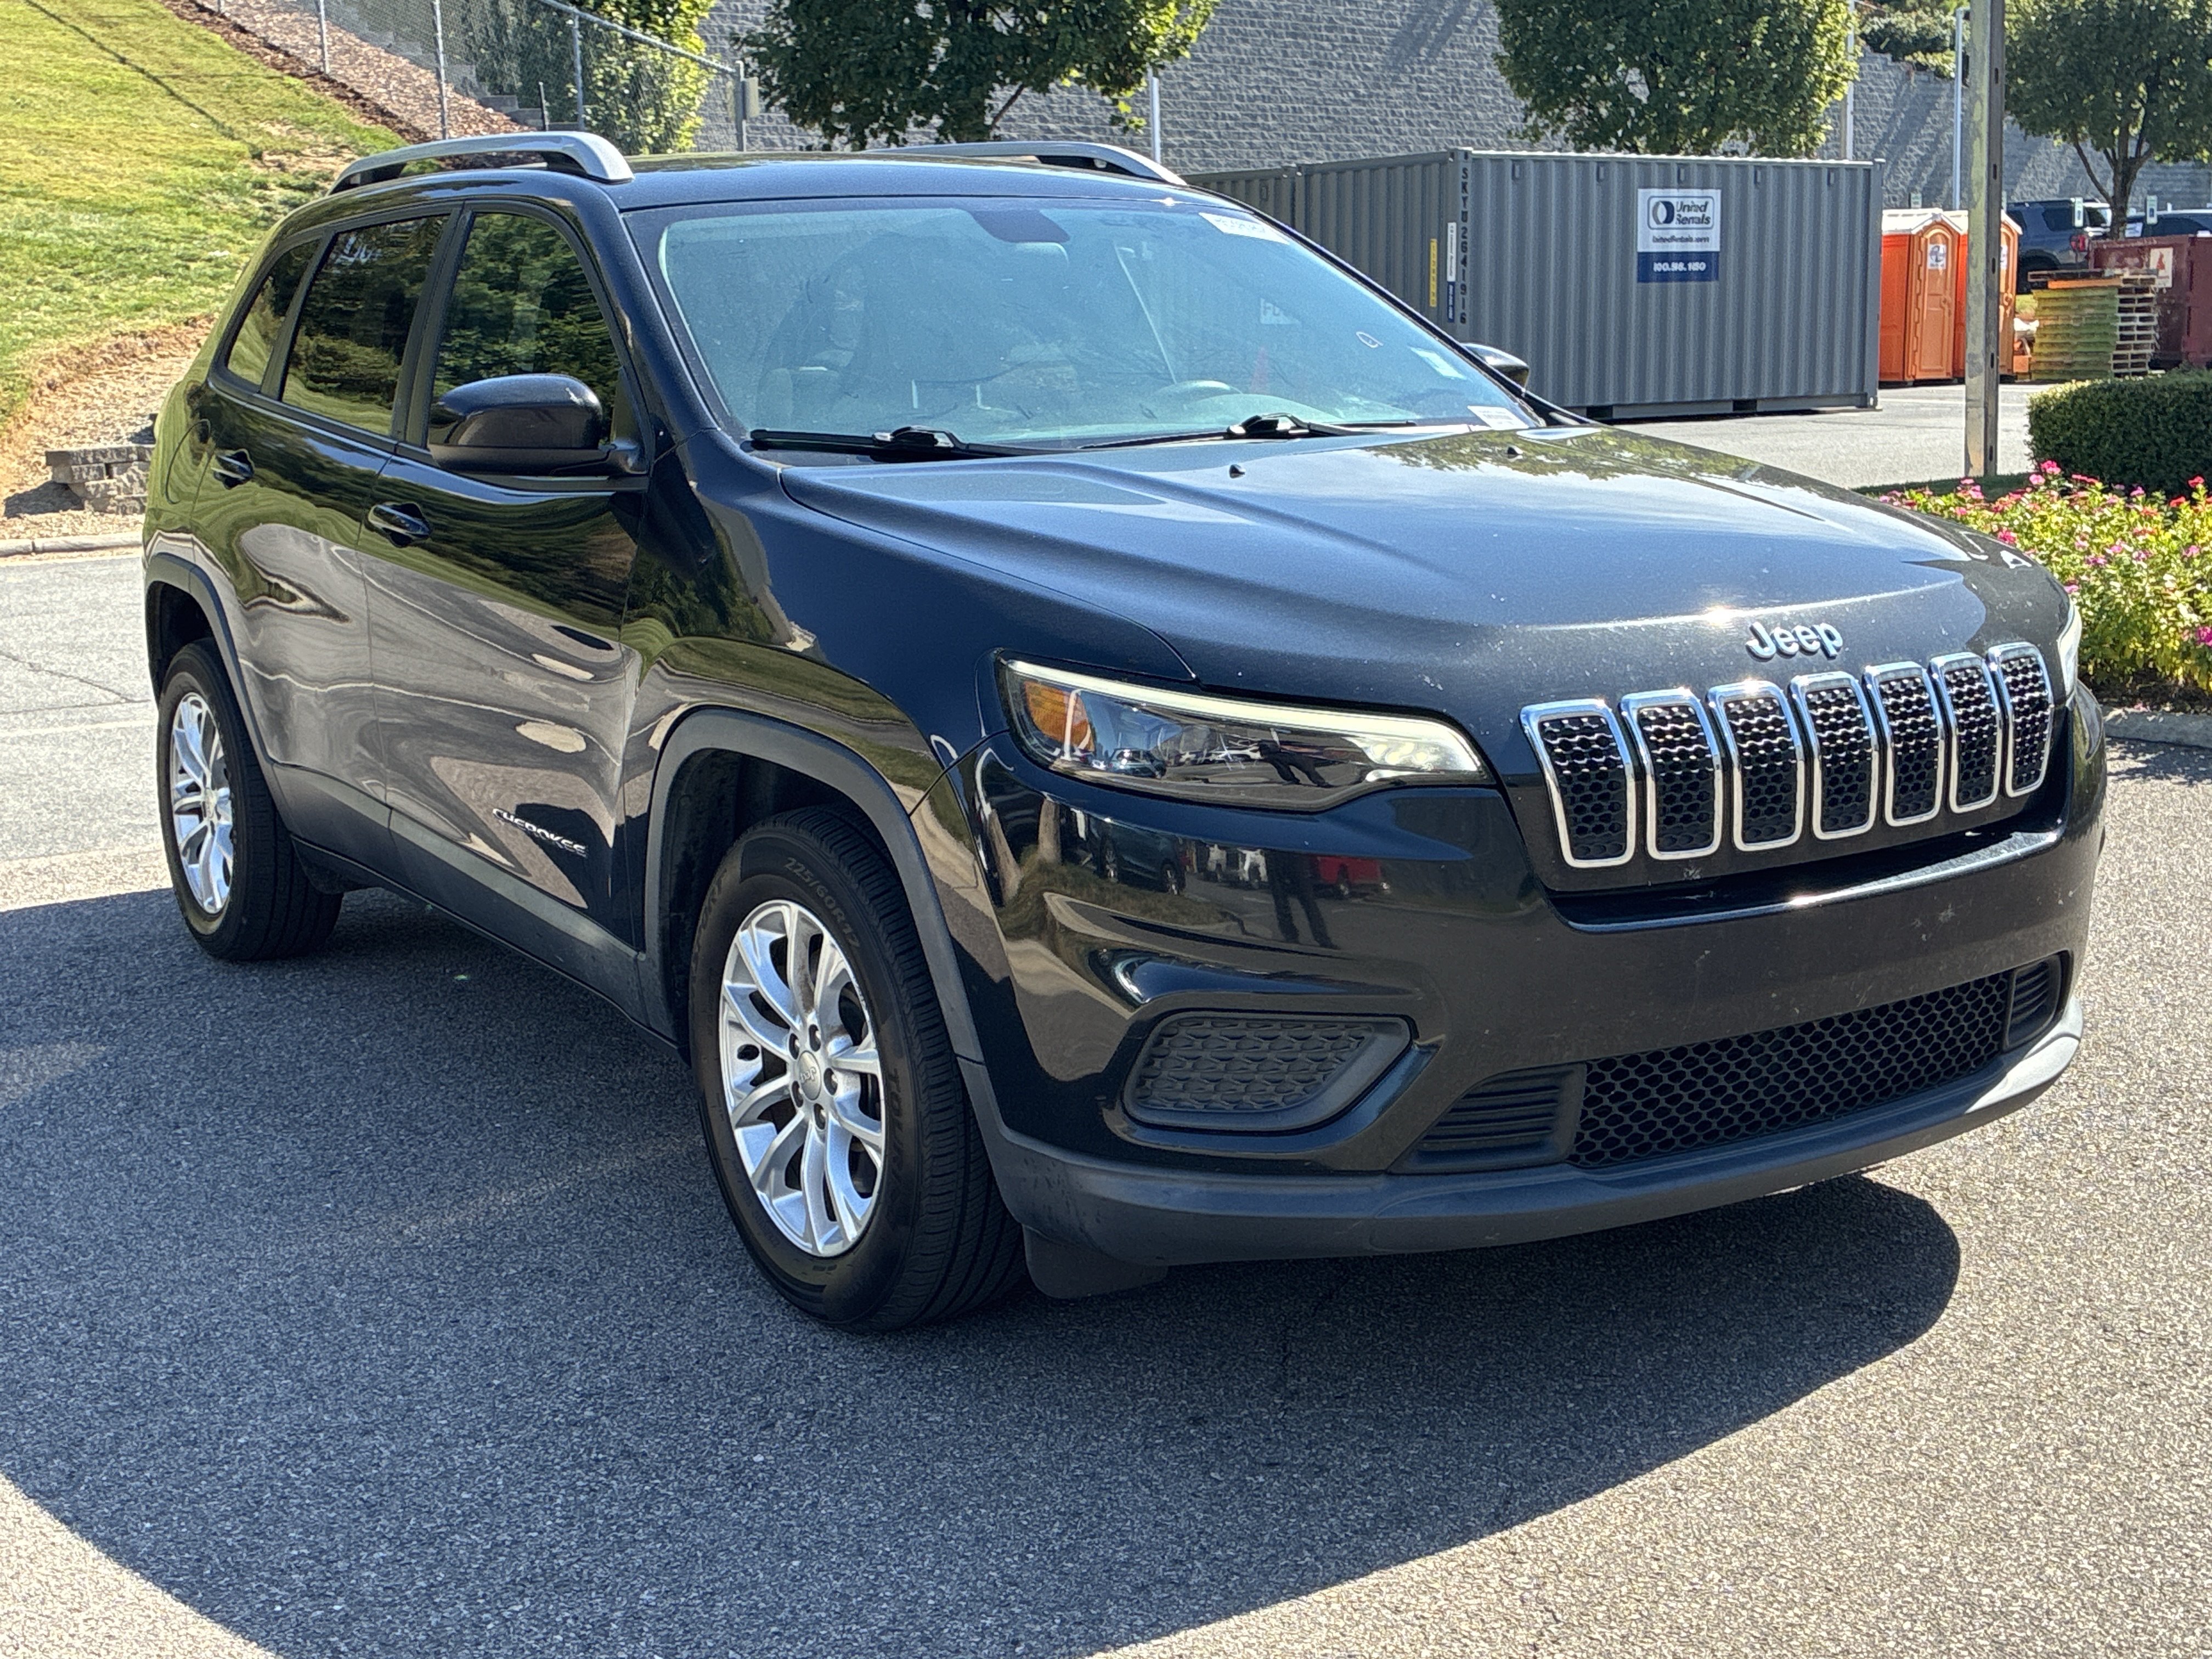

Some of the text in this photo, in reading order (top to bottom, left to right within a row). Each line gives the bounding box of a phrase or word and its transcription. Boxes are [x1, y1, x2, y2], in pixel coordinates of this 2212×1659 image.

[1677, 201, 1708, 212] United
[1745, 622, 1843, 663] Jeep
[784, 857, 860, 947] 225/60R17
